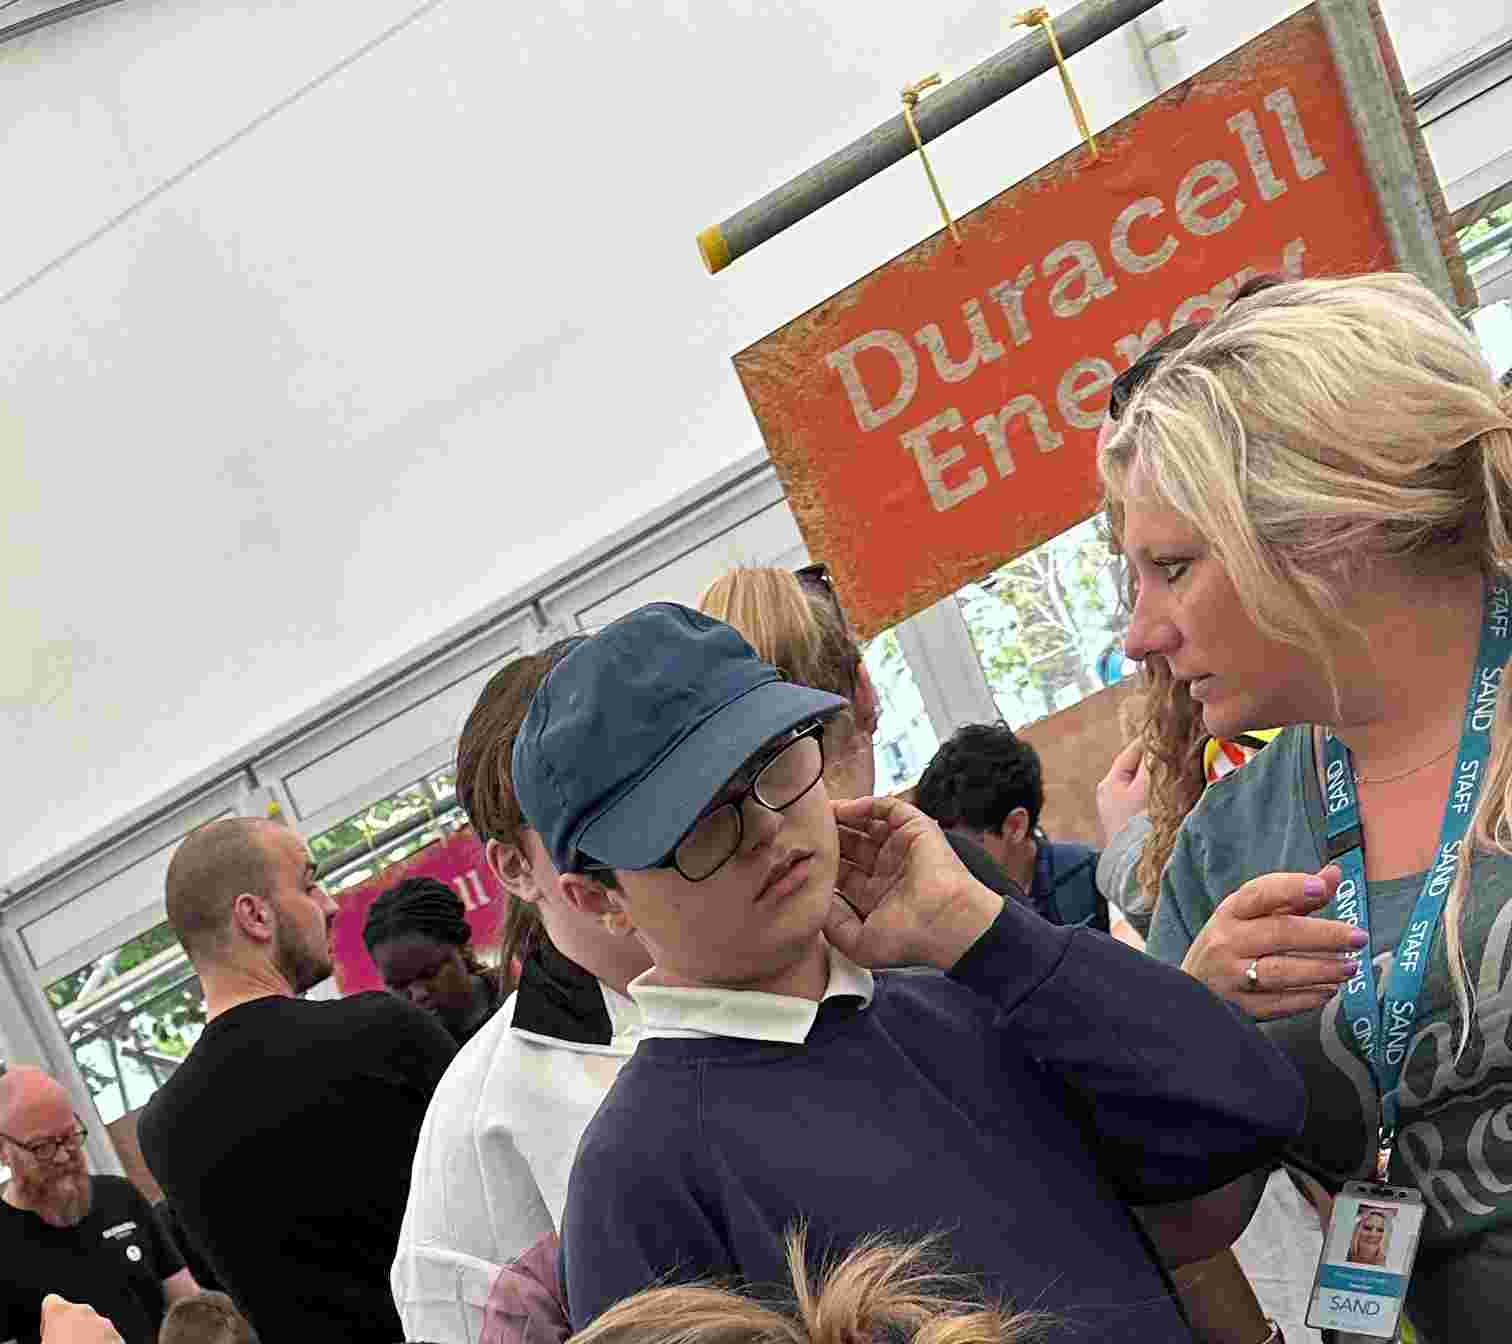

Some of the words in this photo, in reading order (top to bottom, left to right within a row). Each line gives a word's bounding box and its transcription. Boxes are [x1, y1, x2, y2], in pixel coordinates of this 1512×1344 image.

[825, 87, 1327, 433] Duracell
[1489, 586, 1510, 638] STAFF
[1471, 667, 1503, 732] SAND
[1326, 759, 1349, 813] SAND
[1451, 759, 1479, 816] STAFF
[1429, 839, 1463, 897] SAND
[1399, 919, 1428, 973] STAFF
[1385, 1000, 1414, 1066] SAND
[1328, 1295, 1381, 1317] SAND
